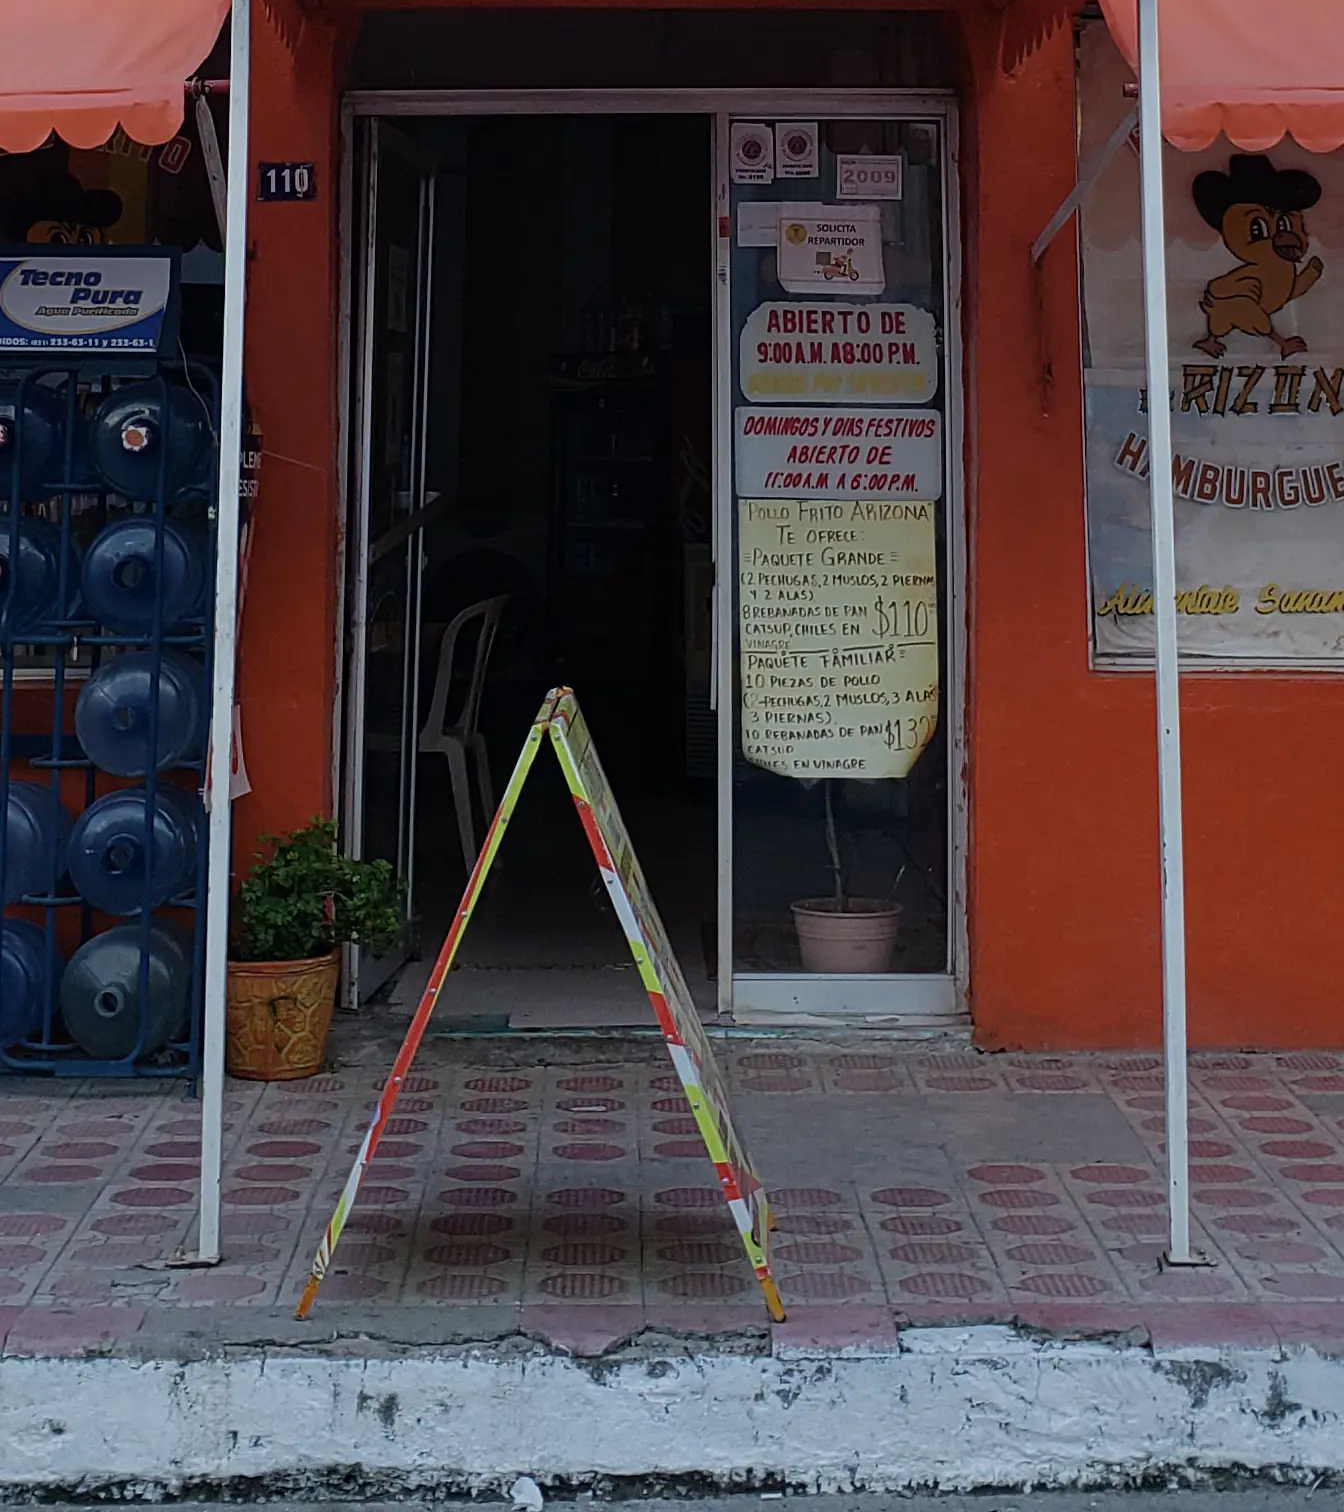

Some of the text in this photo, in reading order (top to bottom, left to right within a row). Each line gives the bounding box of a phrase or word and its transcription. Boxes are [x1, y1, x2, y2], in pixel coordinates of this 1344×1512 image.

[266, 167, 309, 197] 110
[843, 169, 896, 184] 2009
[816, 224, 857, 233] SOLICITA
[807, 236, 865, 246] REPARTIDOR
[20, 269, 101, 286] Tecno
[70, 287, 143, 305] Pura
[35, 306, 139, 317] Agua Purificada
[767, 309, 906, 334] ABIERTO DE
[49, 337, 99, 348] 233-63-11
[888, 342, 920, 365] P.M.
[743, 416, 936, 438] DOMINGOS Y DIAS FESTIVOS
[787, 445, 892, 464] ABIERTO DE
[836, 473, 846, 490] A
[796, 501, 843, 521] FRITO
[776, 525, 796, 545] TE
[821, 546, 885, 567] GRANDE
[881, 575, 889, 586] 2
[764, 590, 772, 600] 2
[825, 606, 838, 617] DE
[844, 605, 867, 618] PAN
[795, 623, 837, 636] CHILES
[843, 624, 860, 635] EN
[748, 649, 896, 670] PAQUETE FAMILIAR
[746, 674, 881, 689] 10 PIEZAS DE POLLO
[892, 692, 900, 704] 3
[750, 712, 759, 723] 3
[746, 723, 883, 740] 10 REBANADAS DE PAN
[793, 759, 810, 769] EN
[812, 758, 867, 769] VINAGRE
